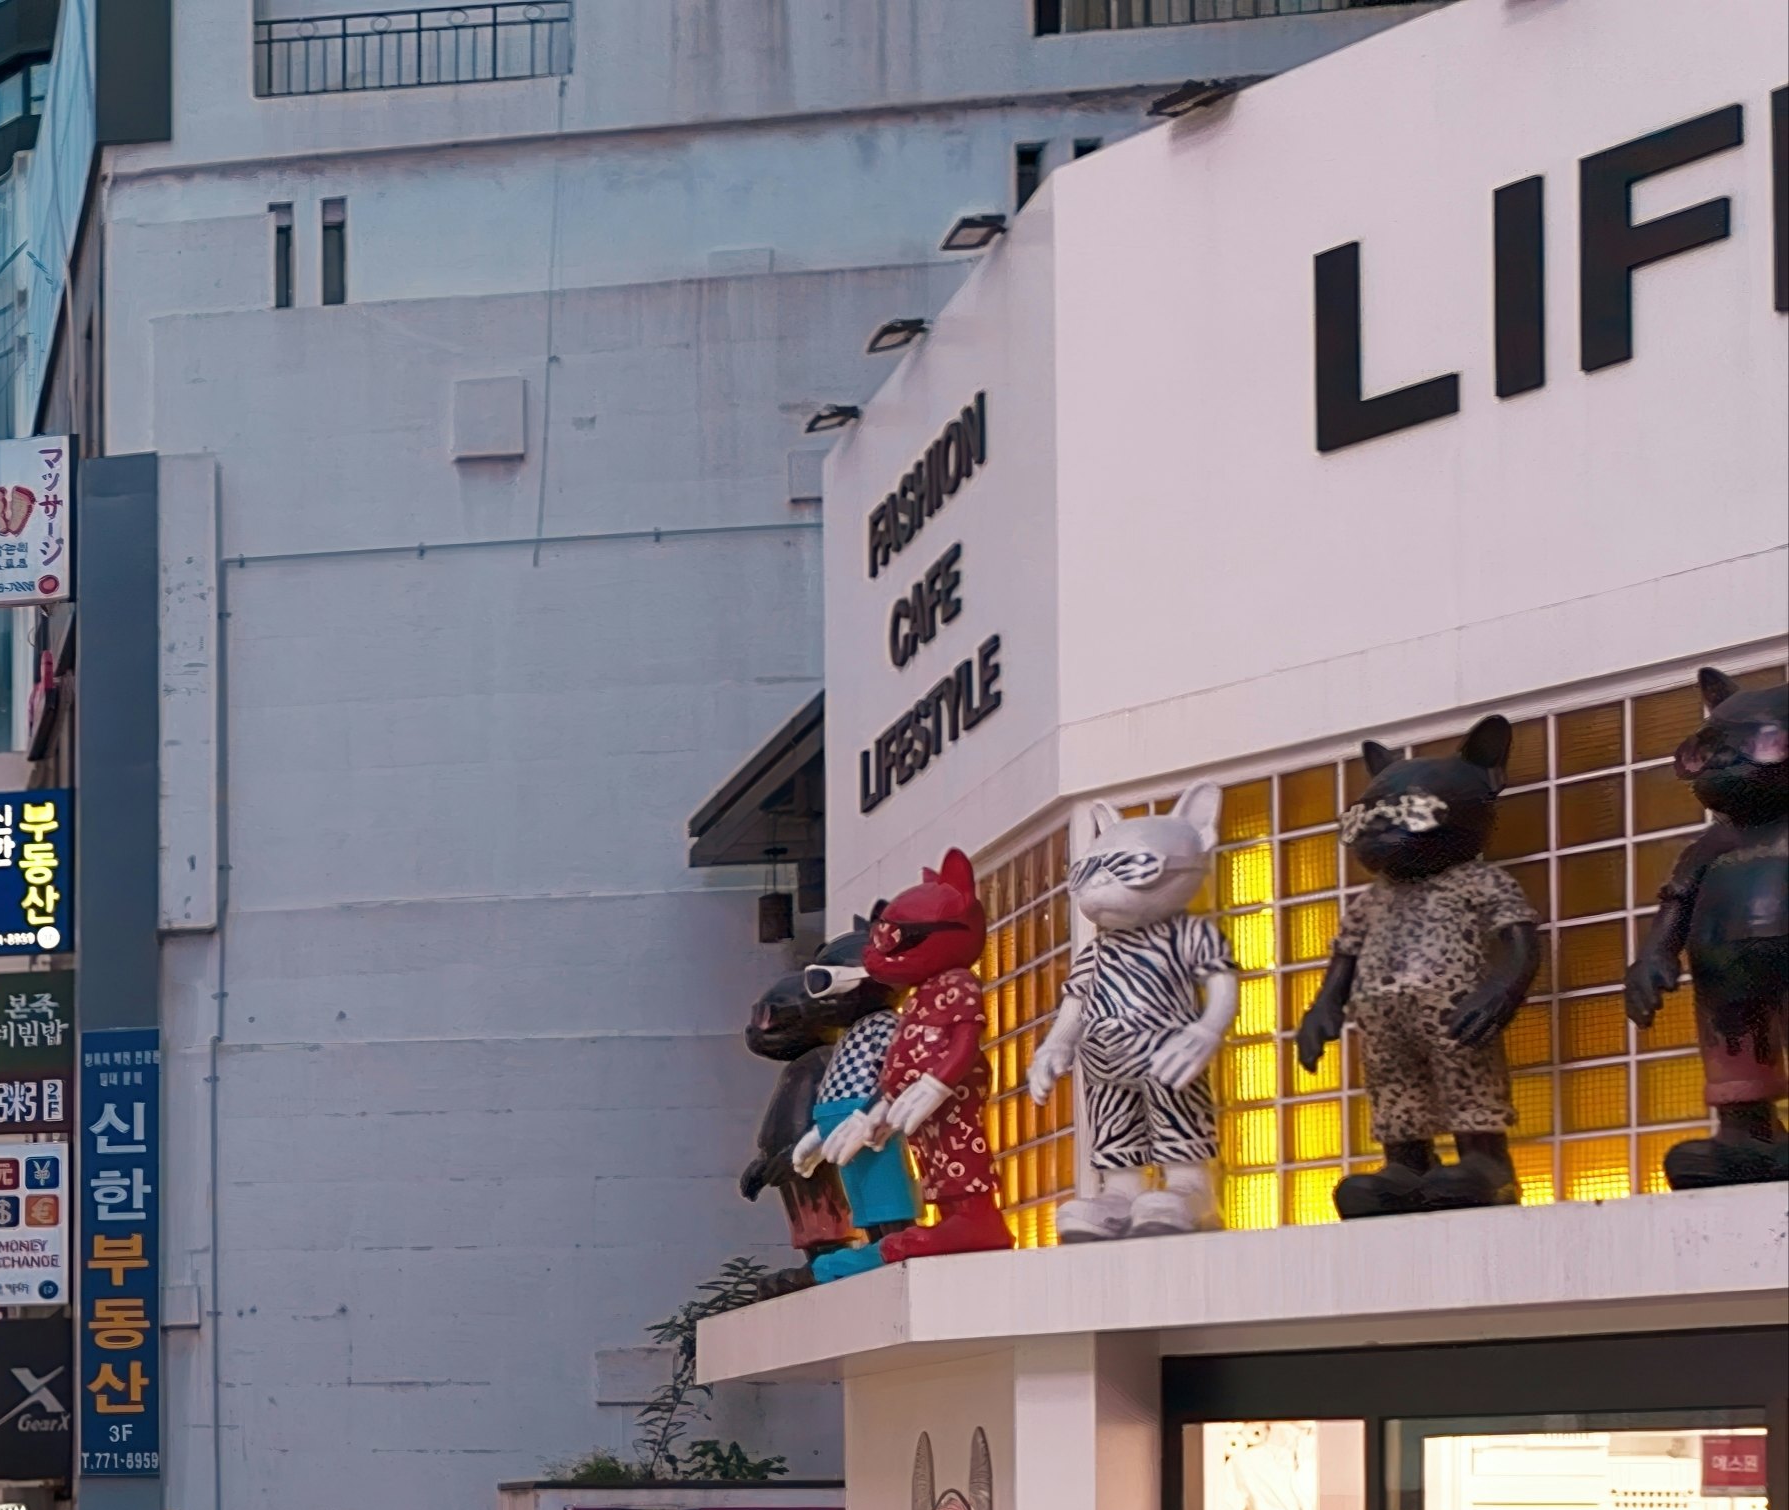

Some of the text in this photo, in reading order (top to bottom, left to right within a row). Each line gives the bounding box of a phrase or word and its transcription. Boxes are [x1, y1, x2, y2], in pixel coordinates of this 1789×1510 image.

[1312, 82, 1789, 456] LIF
[38, 448, 64, 567] マッサージ
[867, 389, 989, 578] FASHION
[887, 539, 964, 670] CAFE
[859, 632, 1002, 813] LIFESTYLE
[18, 802, 61, 926] 부동산
[4, 993, 60, 1019] 본죽
[108, 1424, 134, 1443] 3F
